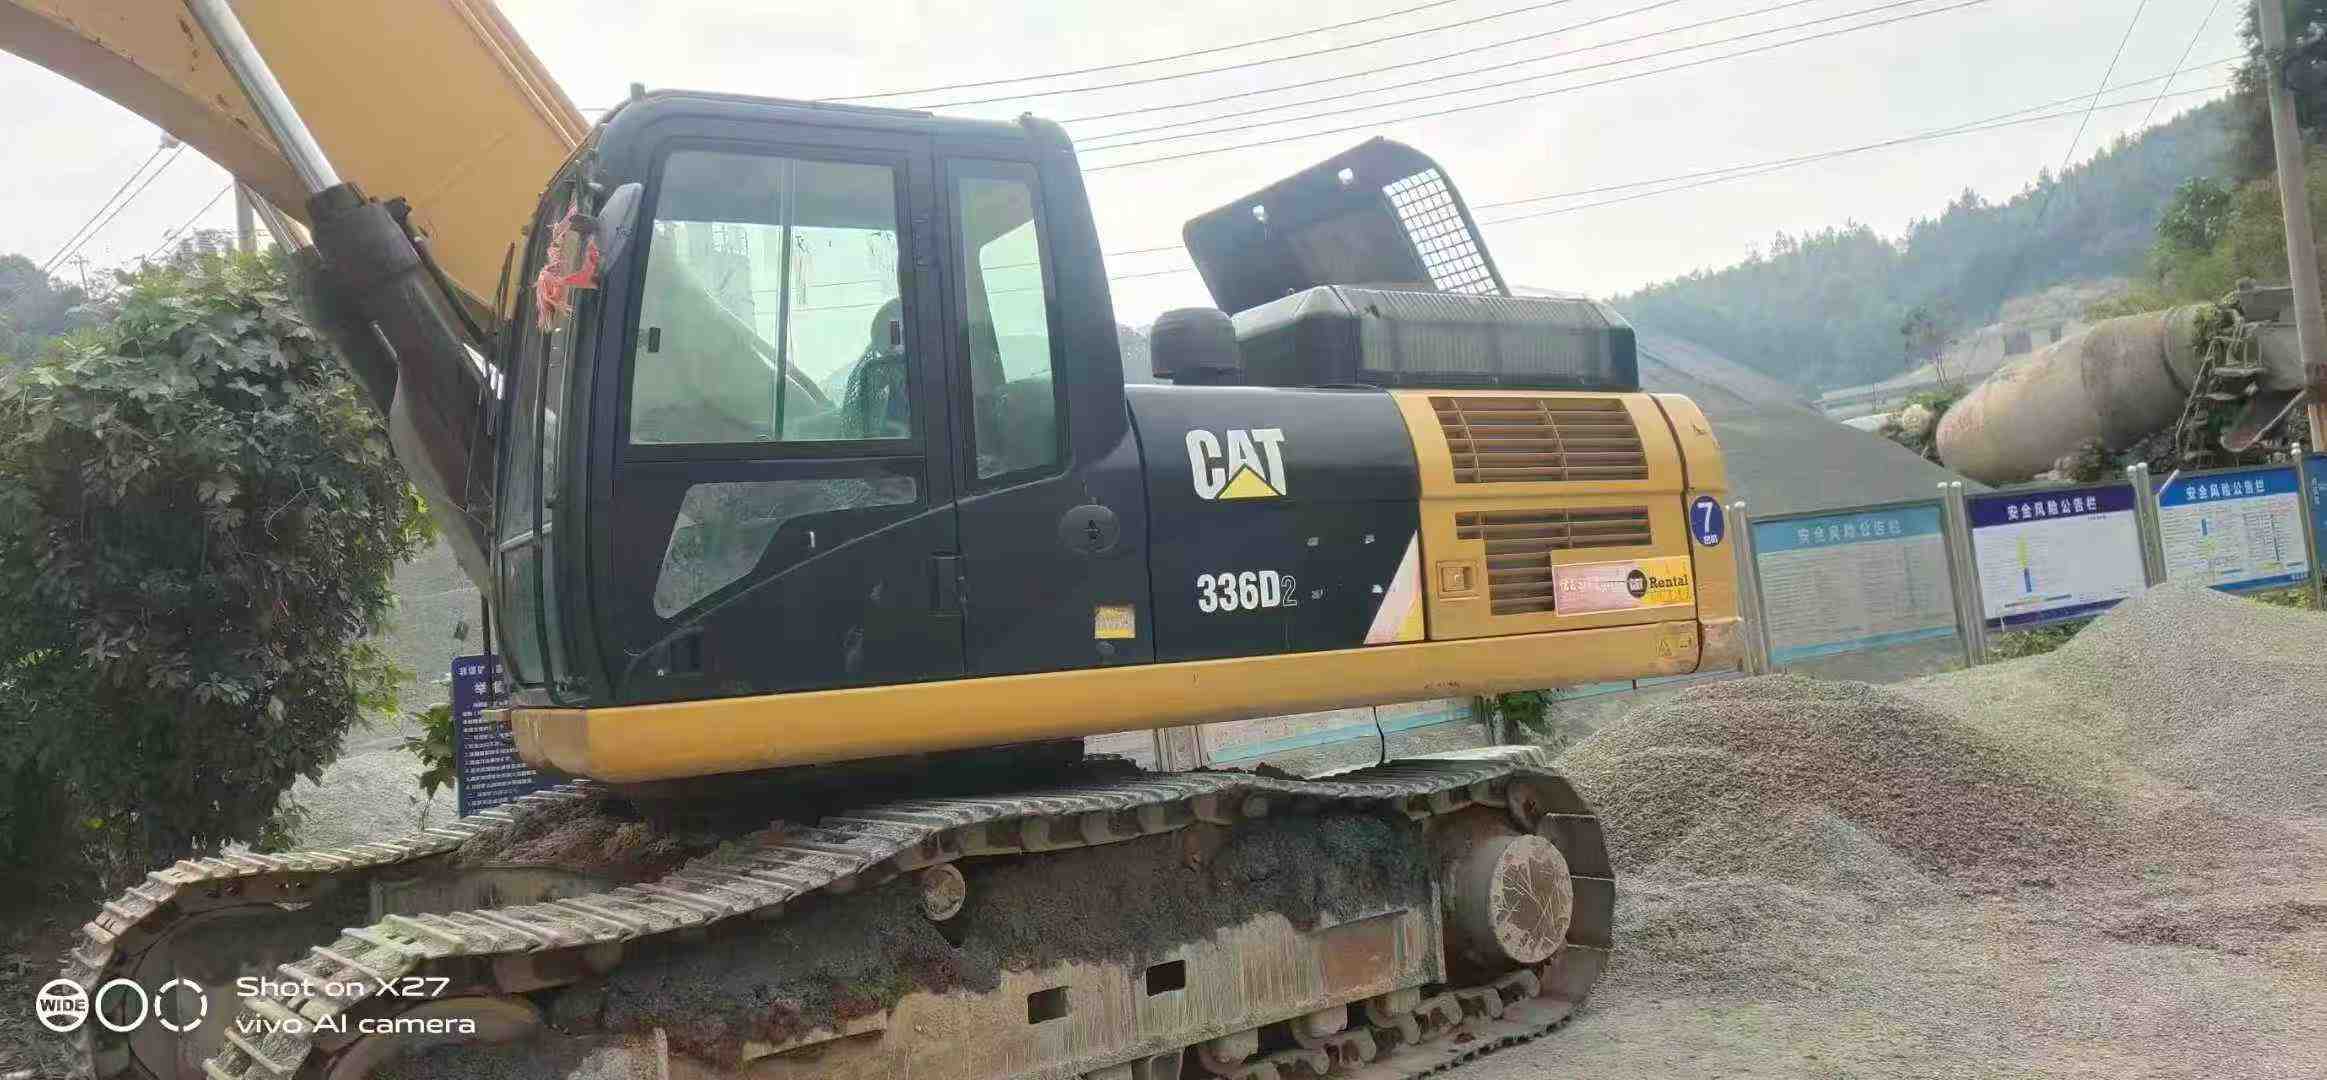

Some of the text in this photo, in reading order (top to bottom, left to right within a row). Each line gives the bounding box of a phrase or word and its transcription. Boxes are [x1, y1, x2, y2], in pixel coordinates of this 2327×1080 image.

[1185, 428, 1287, 500] CAT
[2186, 479, 2266, 501] 安全风险公告栏
[1697, 502, 1712, 533] 7
[2007, 496, 2097, 521] 安全风险公告栏
[1197, 570, 1297, 613] 336D2
[1649, 574, 1689, 589] Rental
